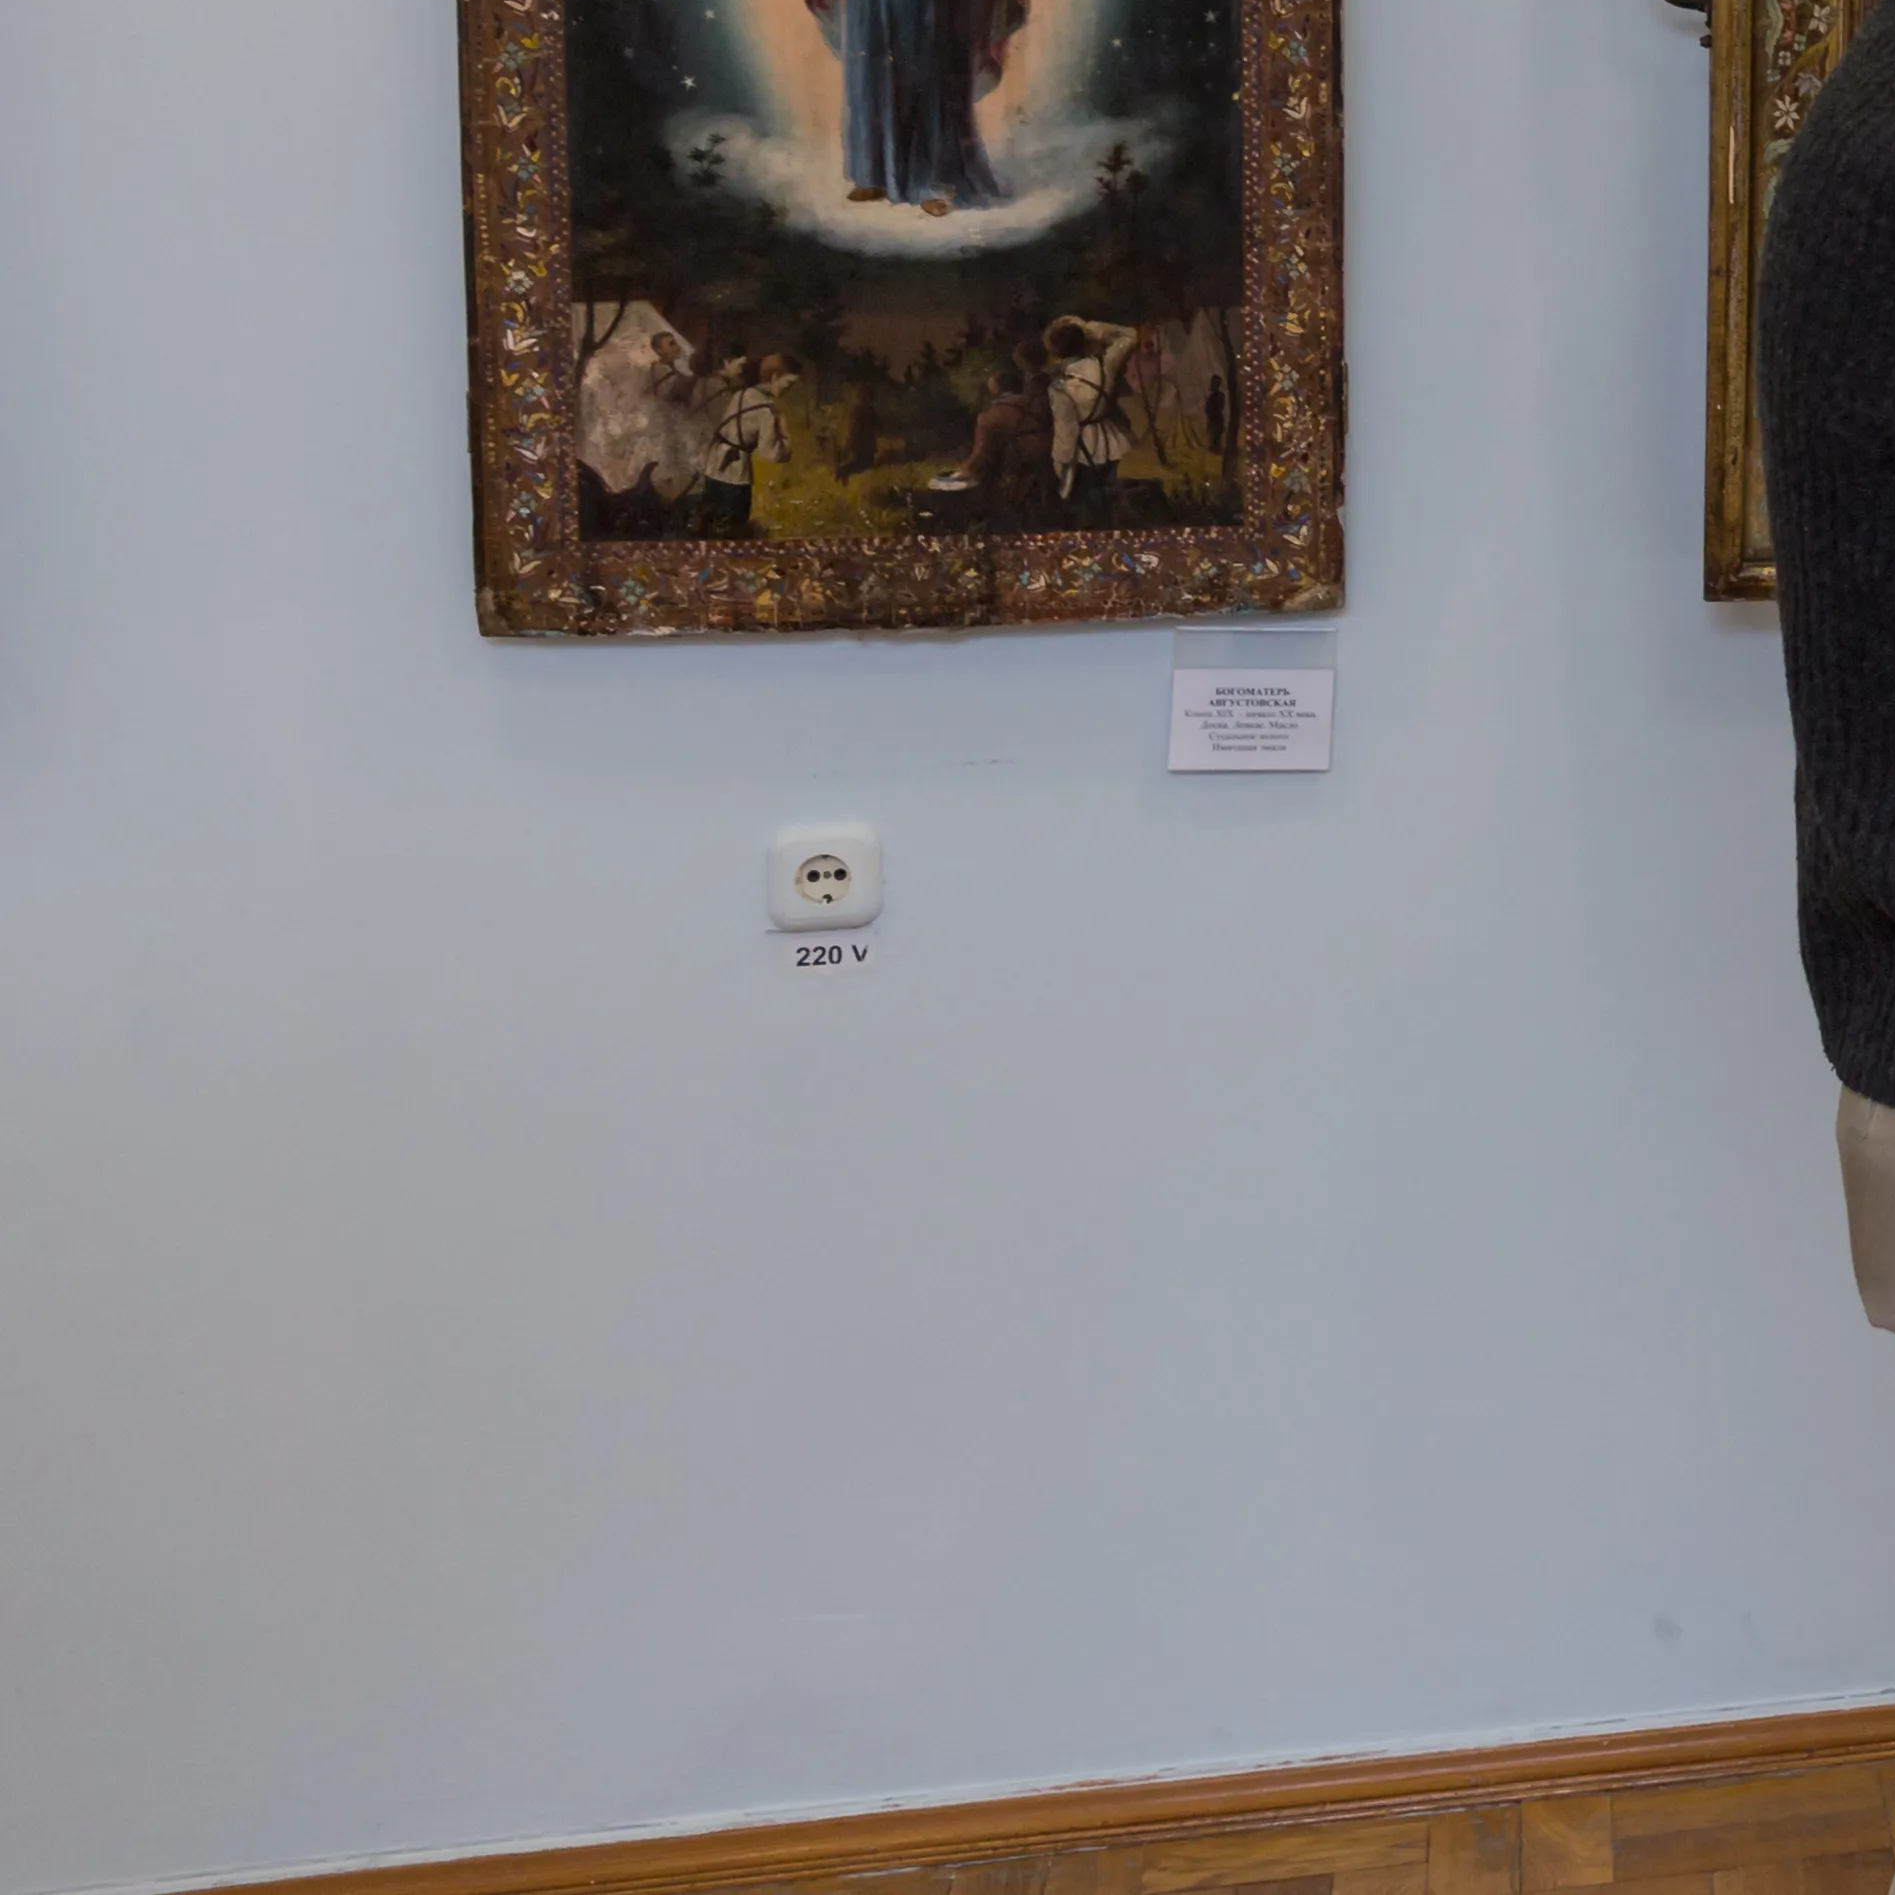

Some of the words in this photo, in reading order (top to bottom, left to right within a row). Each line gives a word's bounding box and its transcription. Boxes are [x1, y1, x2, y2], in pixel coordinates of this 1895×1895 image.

[1215, 687, 1290, 696] БОГОМАТЕРЬ
[1209, 698, 1296, 708] АВГУСТОВСКАЯ
[796, 945, 842, 966] 220
[851, 944, 868, 962] V
